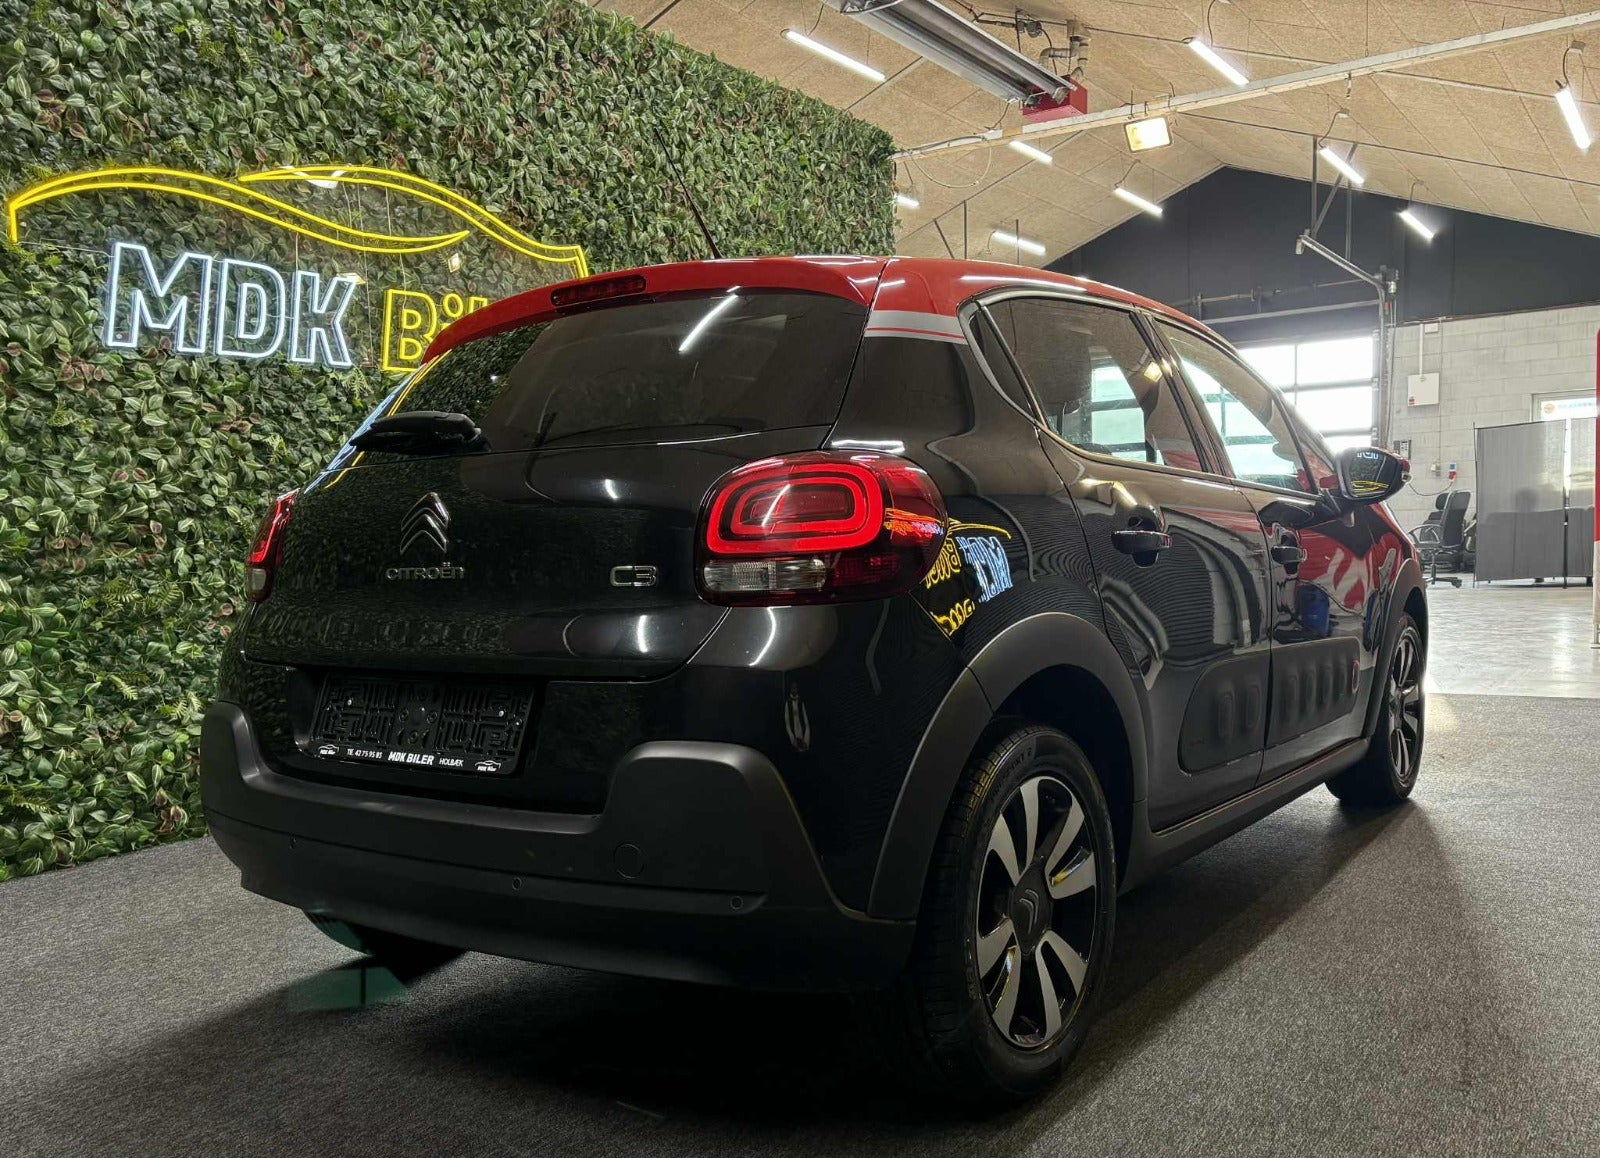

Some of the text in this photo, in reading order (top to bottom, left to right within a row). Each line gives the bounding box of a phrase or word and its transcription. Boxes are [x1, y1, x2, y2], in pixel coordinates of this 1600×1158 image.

[106, 241, 358, 368] MDK
[610, 565, 657, 587] C3
[387, 751, 406, 762] MDK
[406, 752, 435, 765] BILER
